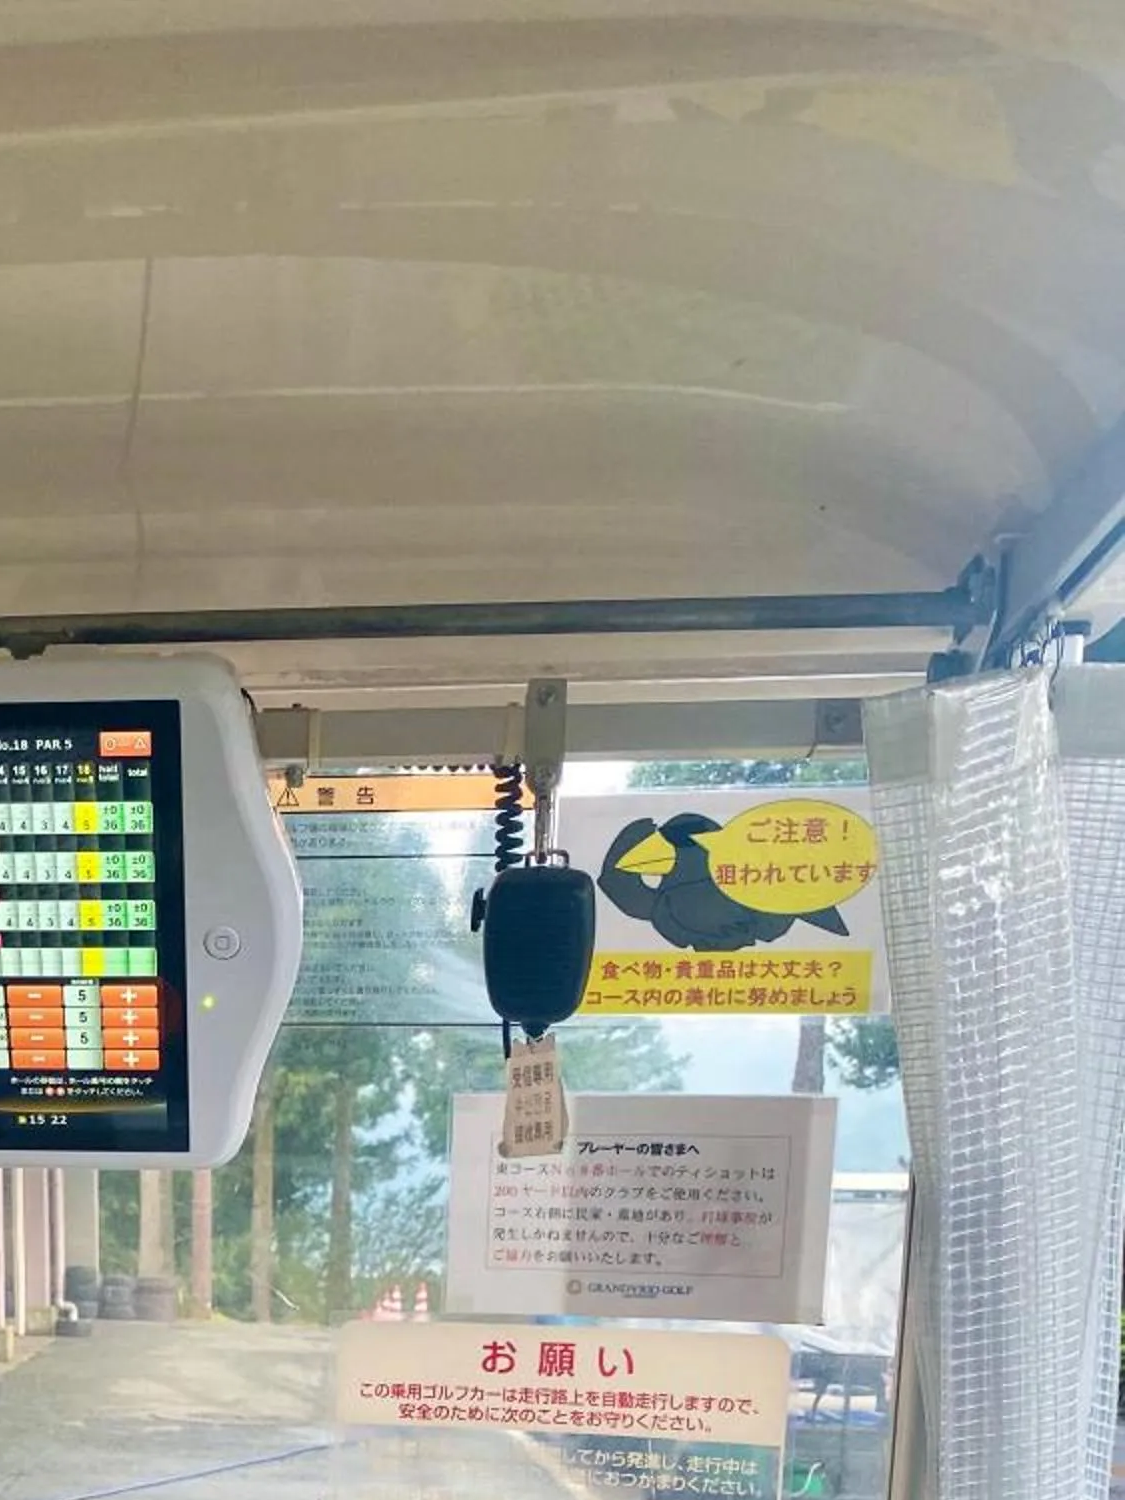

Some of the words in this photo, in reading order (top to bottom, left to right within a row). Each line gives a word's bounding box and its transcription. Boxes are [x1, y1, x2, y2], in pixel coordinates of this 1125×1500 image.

[36, 739, 62, 750] PAR
[64, 739, 73, 750] 5
[13, 765, 26, 776] 15
[34, 765, 48, 776] 16
[56, 765, 68, 776] 17
[127, 768, 148, 777] total
[317, 787, 374, 805] 警告
[746, 818, 849, 844] ご注意！
[716, 863, 877, 887] 狙われています
[601, 960, 843, 980] 食べ物・貴重品は大丈夫？
[78, 990, 86, 1001] 5
[586, 987, 858, 1007] コース内の美化に努めましょう
[79, 1012, 87, 1022] 5
[80, 1033, 88, 1044] 5
[50, 1115, 68, 1125] 22
[577, 1142, 700, 1156] プレーヤーの皆さまへ
[481, 1340, 635, 1377] お願い
[360, 1382, 759, 1415] この乗用ゴルフカーは走行路上を自動走行しますので、
[398, 1403, 712, 1432] 安全のために次のことをお守りください。
